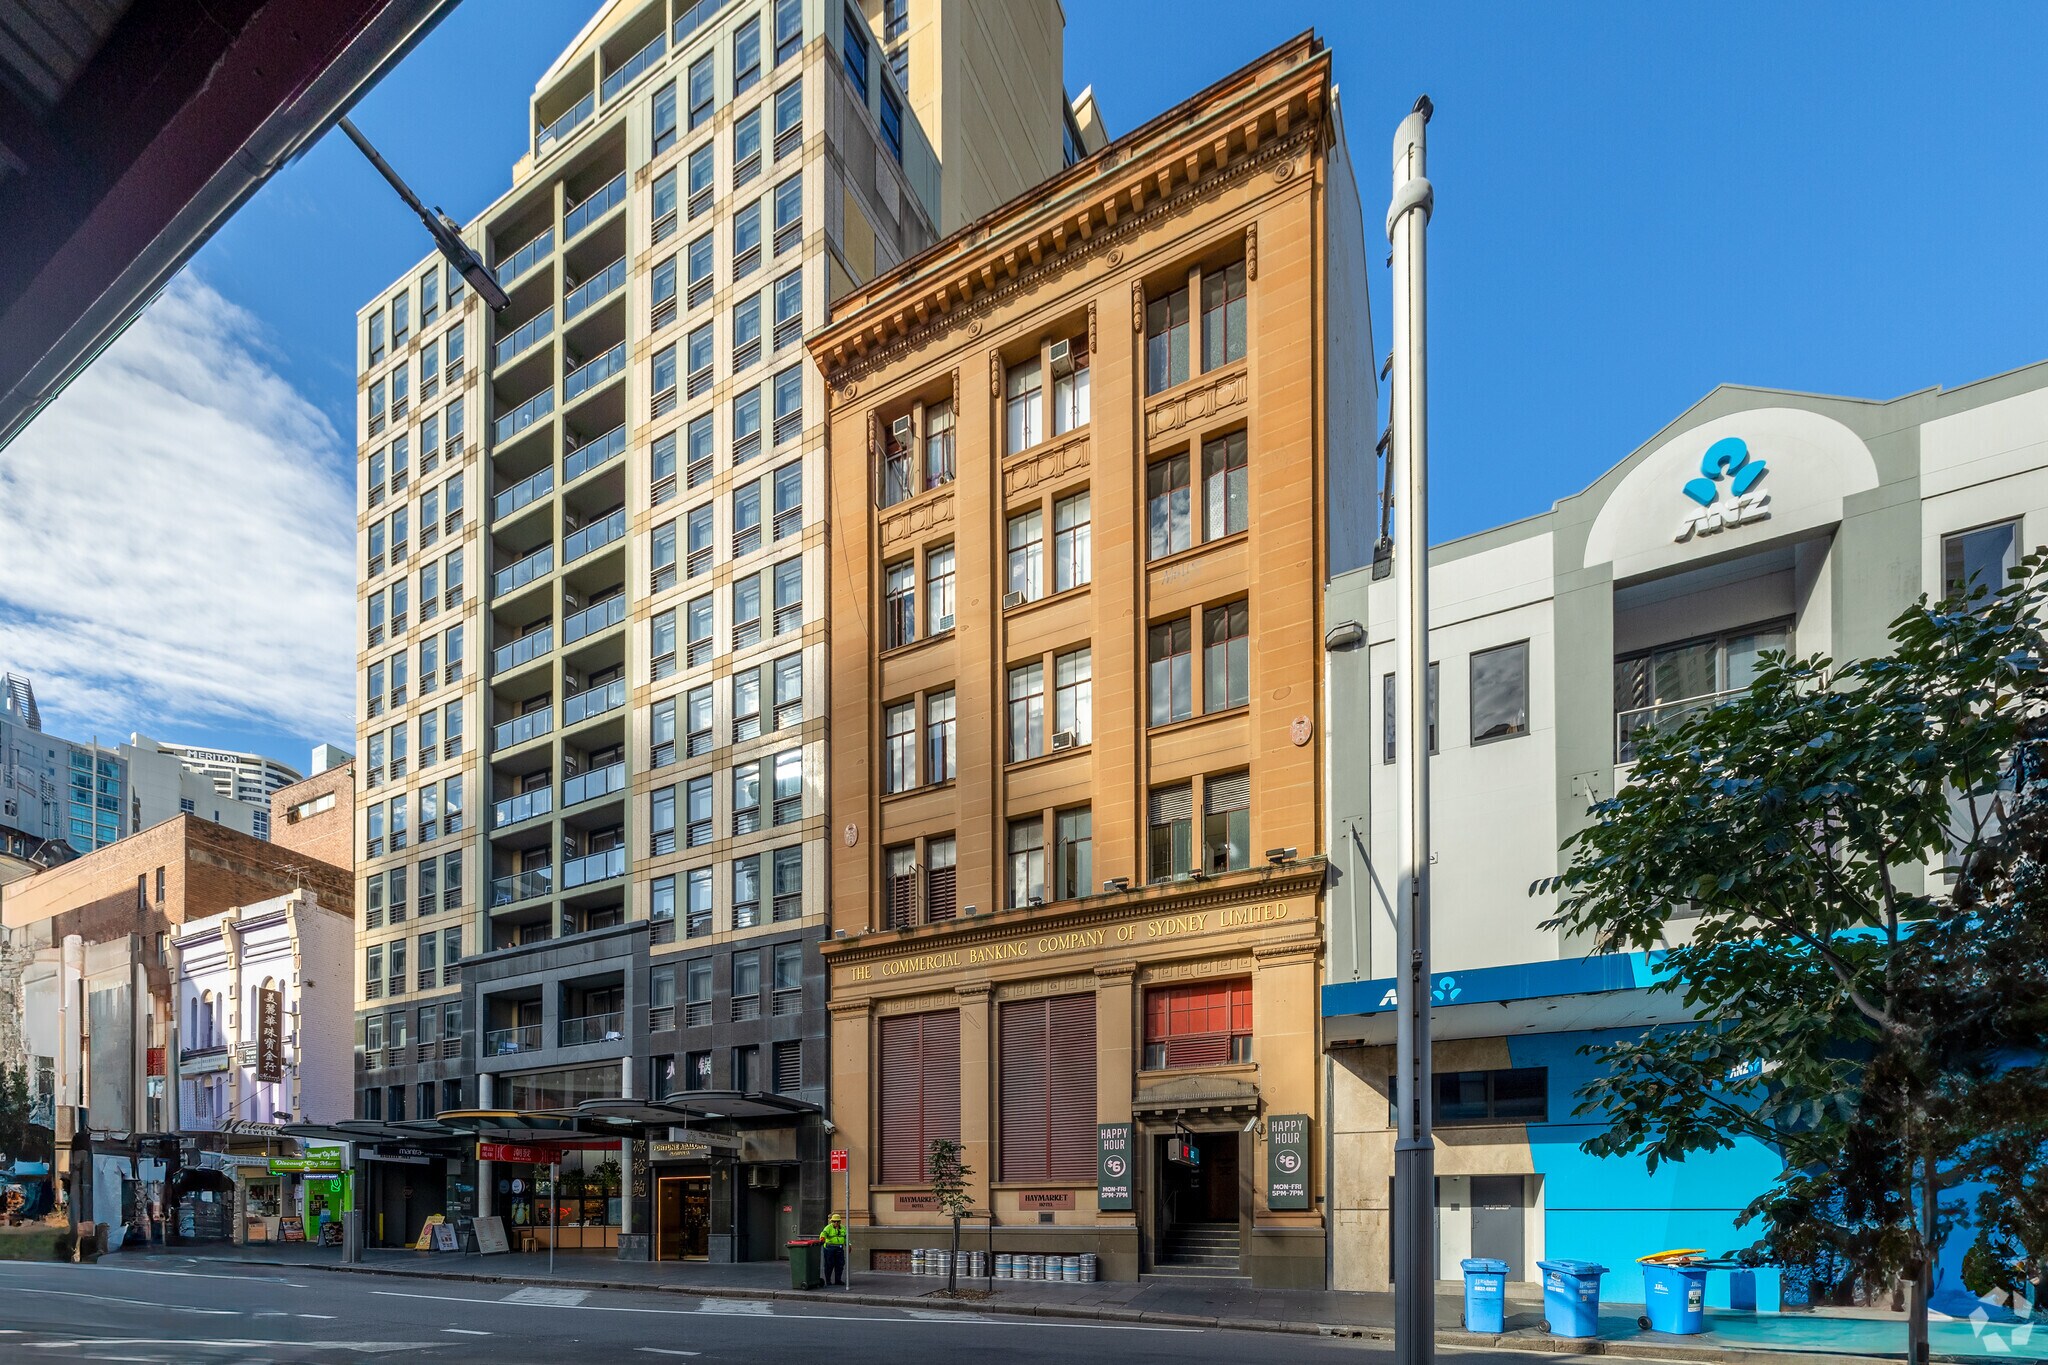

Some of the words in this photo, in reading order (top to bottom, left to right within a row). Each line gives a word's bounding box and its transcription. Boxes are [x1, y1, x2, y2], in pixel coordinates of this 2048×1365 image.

[1674, 488, 1769, 542] ANZ
[187, 750, 237, 763] MERITON
[851, 965, 871, 981] THE
[882, 952, 961, 976] COMMERCIAL
[970, 941, 1028, 964] BANKING
[1038, 929, 1107, 953] COMPANY
[1117, 924, 1136, 942] OF
[1148, 914, 1208, 937] SYDNEY
[1220, 902, 1288, 928] LIMITED
[1730, 1061, 1748, 1079] ANZ
[220, 1117, 287, 1134] Melewa
[1271, 1120, 1303, 1132] HAPPY
[1101, 1128, 1128, 1139] HAPPY
[1275, 1132, 1300, 1144] HOUR
[1104, 1139, 1125, 1150] HOUR
[399, 1148, 422, 1156] mantra
[275, 1159, 303, 1167] Discount
[1107, 1160, 1121, 1172] $6
[1279, 1154, 1295, 1168] $6
[1024, 1194, 1068, 1202] HAYMARKET
